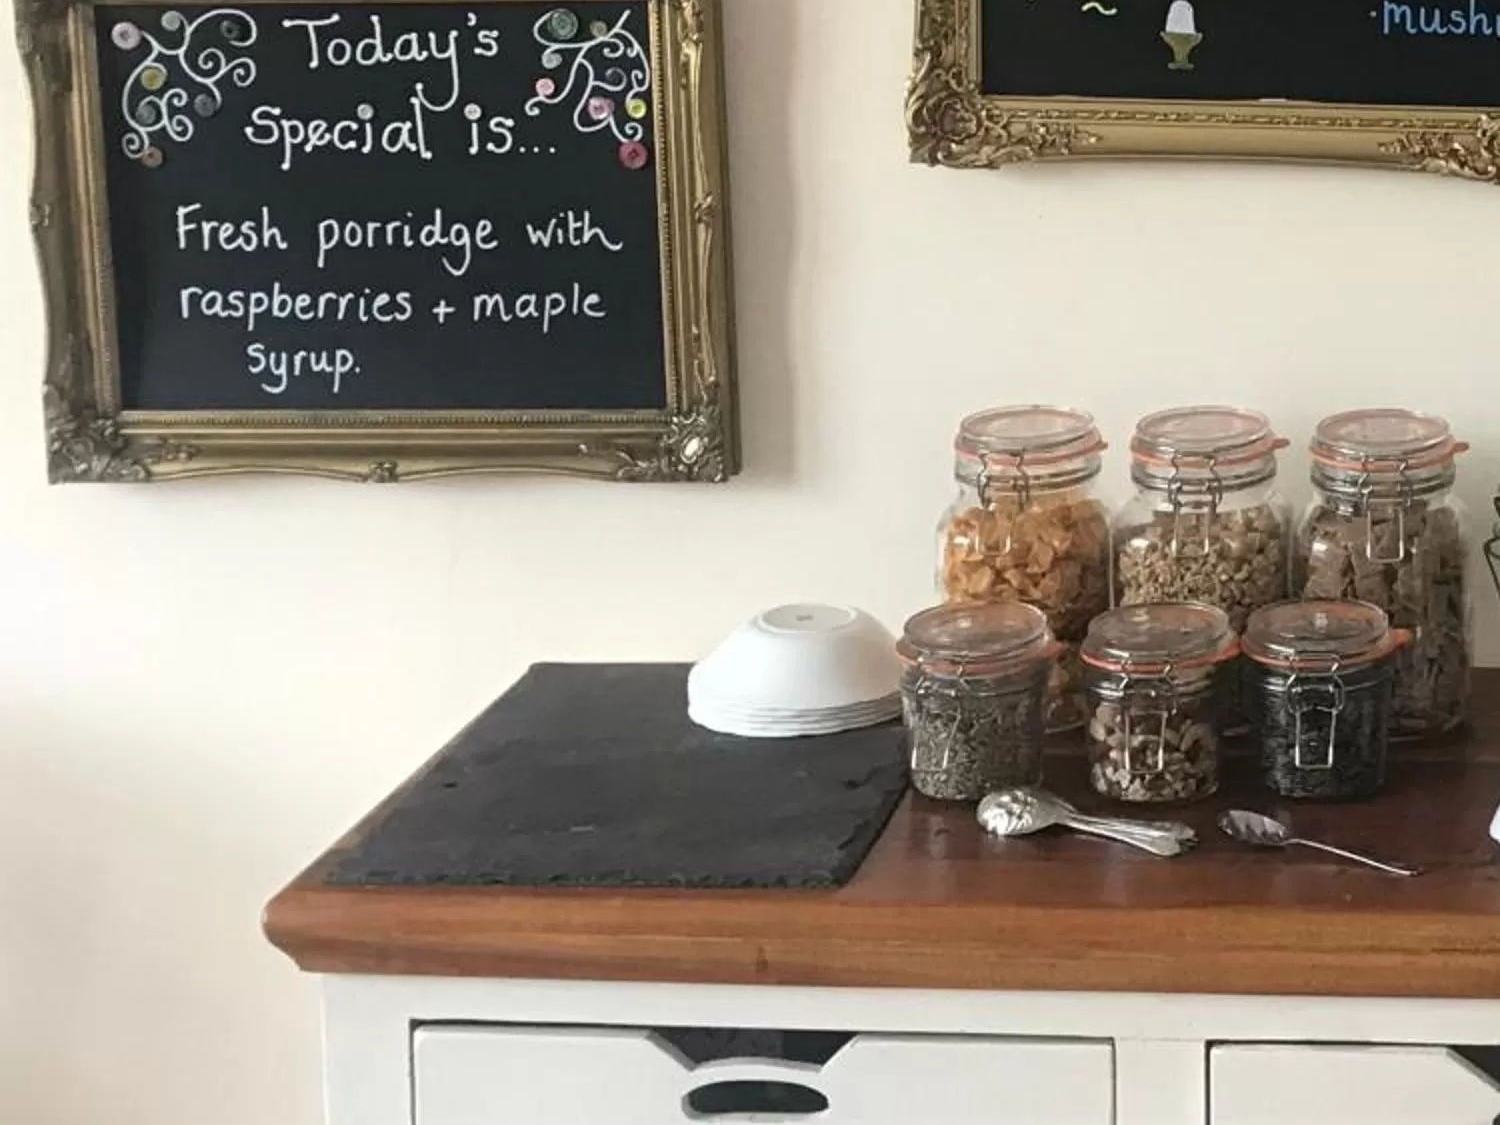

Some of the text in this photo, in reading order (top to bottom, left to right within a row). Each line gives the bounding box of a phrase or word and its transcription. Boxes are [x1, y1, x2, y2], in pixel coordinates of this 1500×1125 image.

[283, 13, 498, 111] Today's
[244, 95, 432, 171] Special
[176, 204, 623, 276] Fresh porridge with
[180, 283, 608, 333] raspberries + maple
